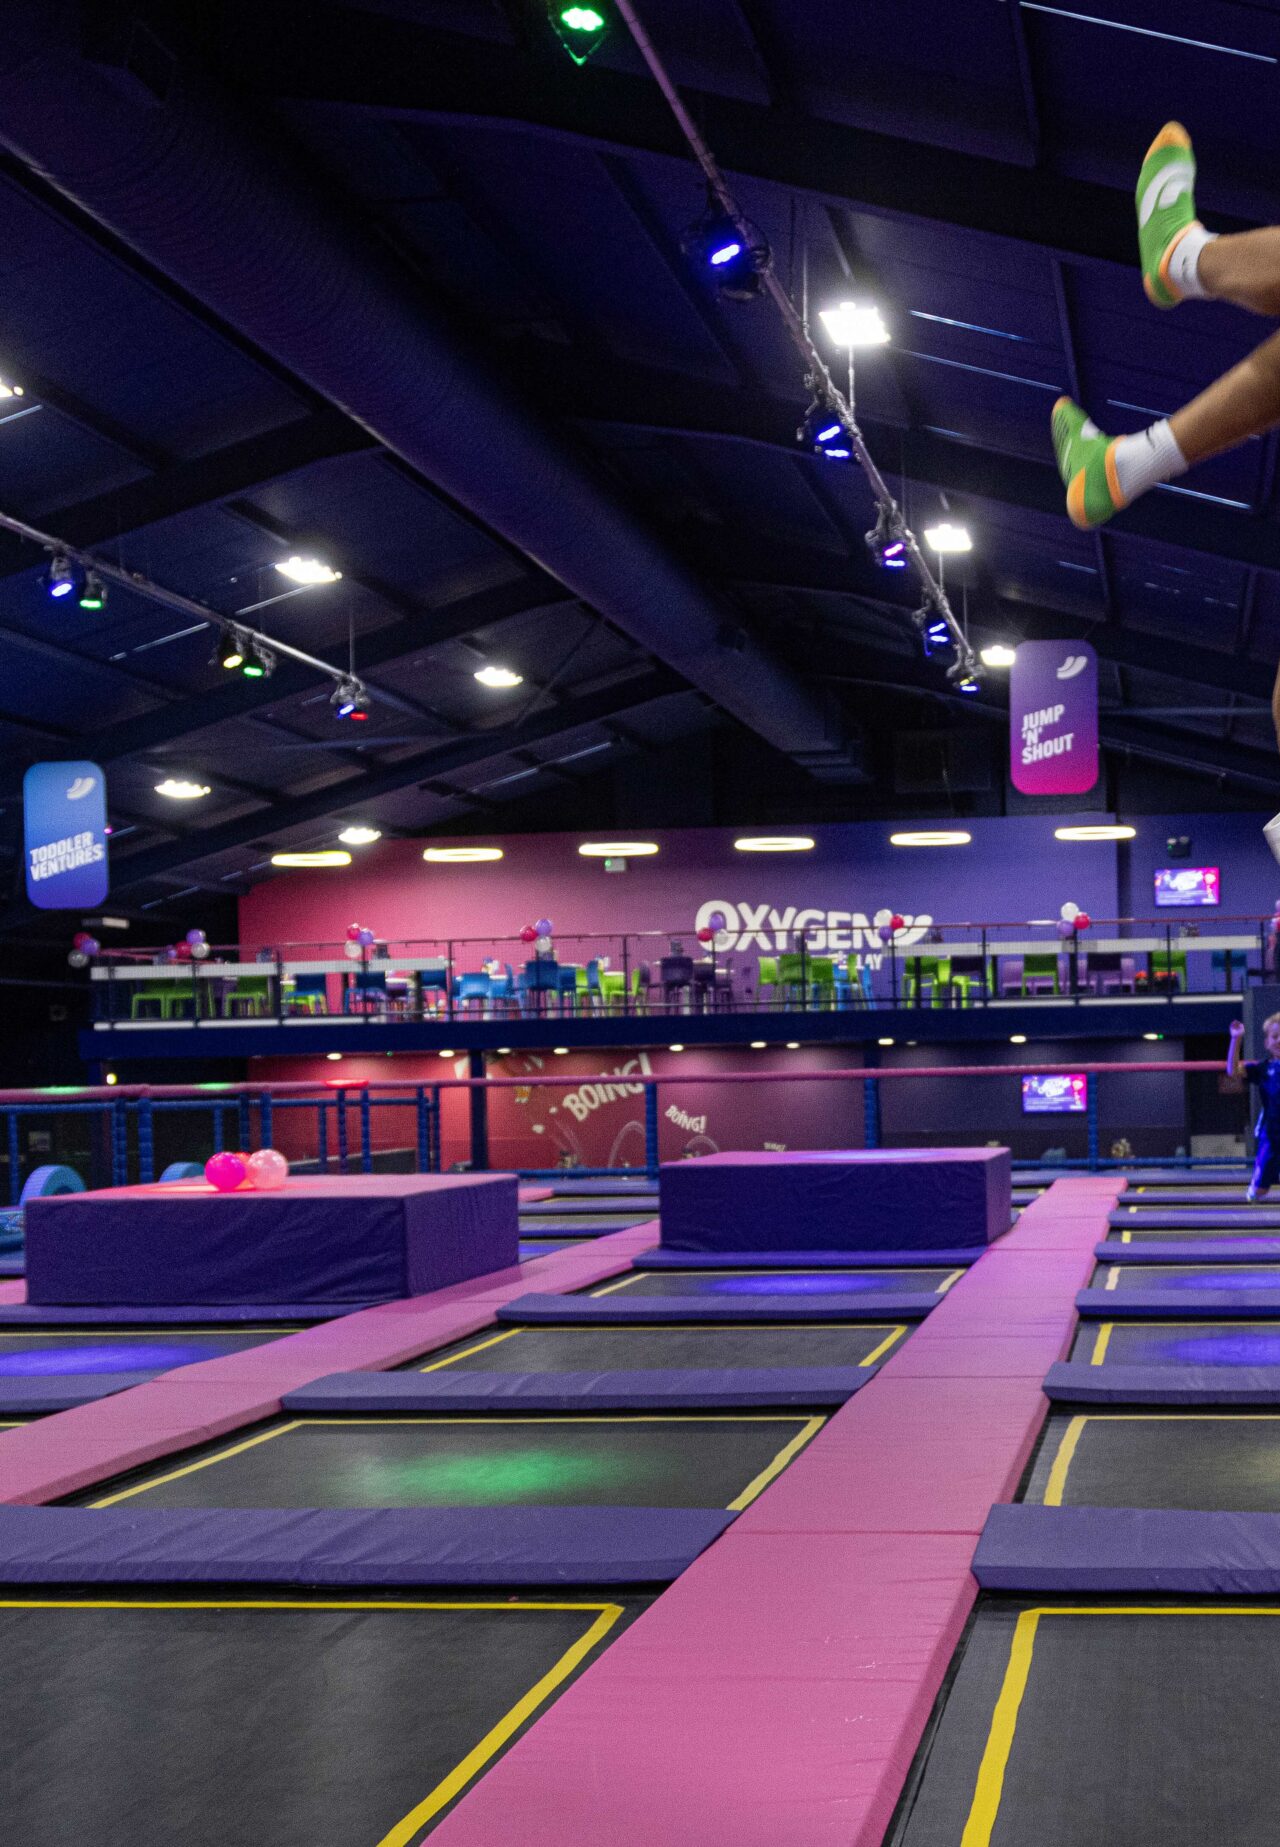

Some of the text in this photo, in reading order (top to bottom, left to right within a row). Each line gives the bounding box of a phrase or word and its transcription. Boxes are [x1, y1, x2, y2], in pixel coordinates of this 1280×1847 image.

[1021, 704, 1065, 732] JUMP
[1021, 732, 1074, 764] SHOUT
[30, 831, 94, 865] TODDLER
[30, 843, 105, 881] VENTURES
[695, 900, 882, 952] OXYGEN
